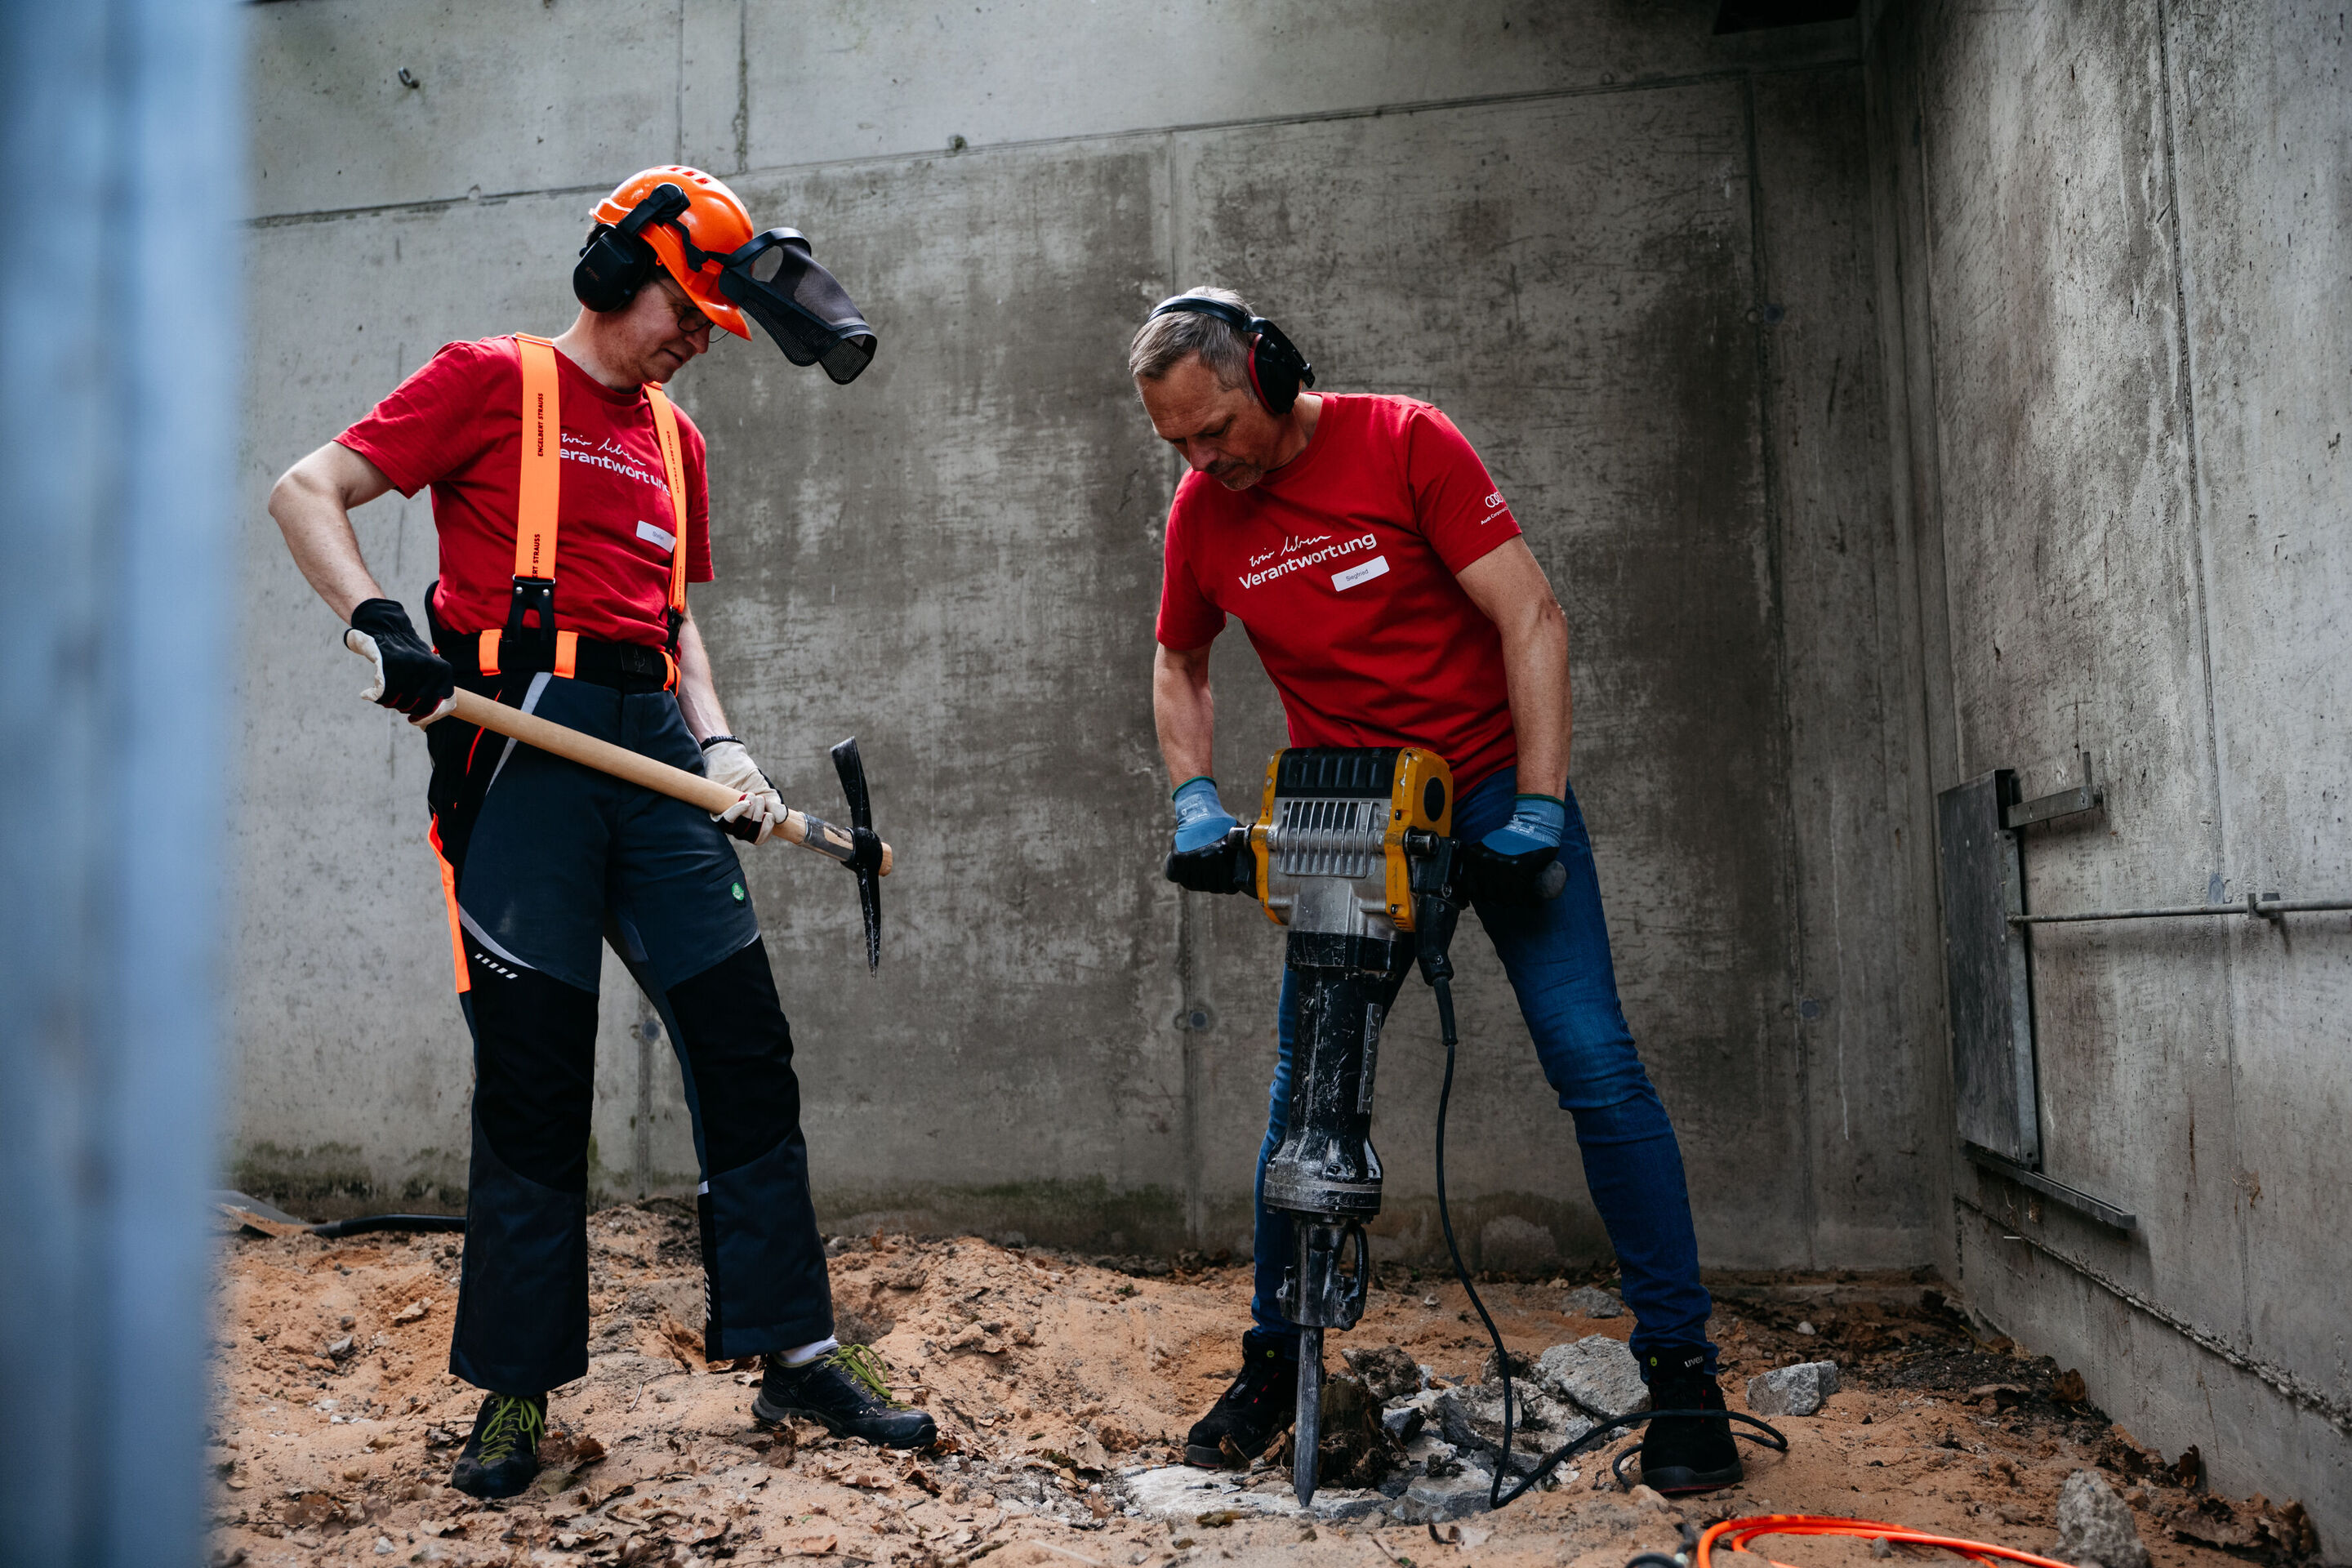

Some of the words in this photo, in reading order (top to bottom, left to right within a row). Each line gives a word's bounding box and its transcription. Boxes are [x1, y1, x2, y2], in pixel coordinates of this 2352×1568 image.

[560, 448, 671, 497] erantwortung
[1238, 532, 1378, 590] Verantwortung
[1345, 568, 1370, 581] Siegfried
